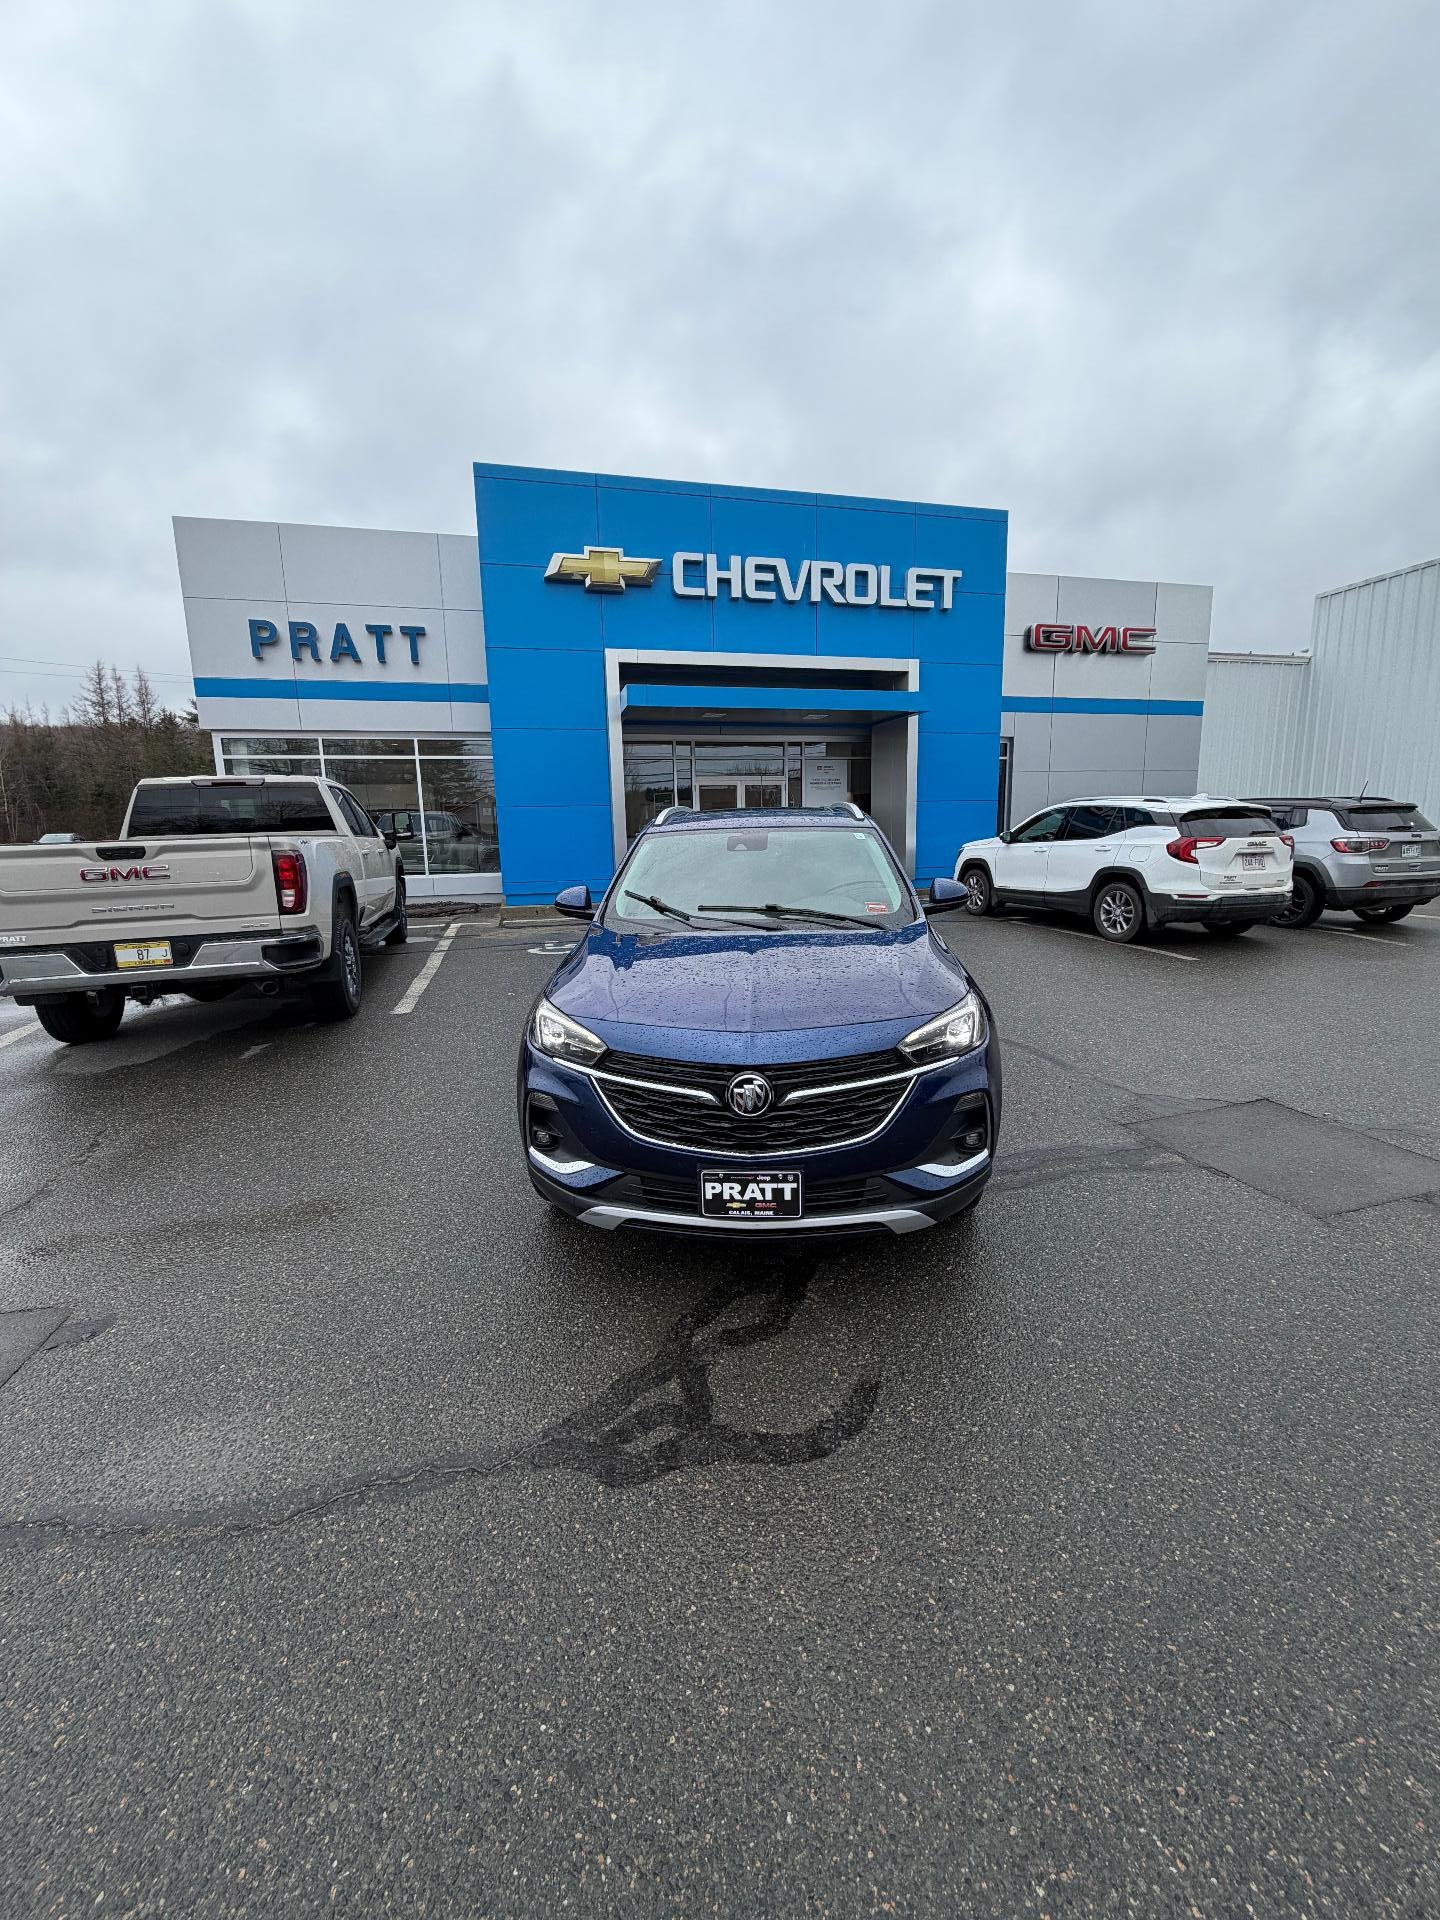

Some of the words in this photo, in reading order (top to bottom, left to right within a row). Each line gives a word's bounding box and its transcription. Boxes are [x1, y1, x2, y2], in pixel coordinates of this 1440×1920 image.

[672, 551, 963, 610] CHEVROLET
[248, 619, 427, 665] PRATT
[1025, 623, 1157, 655] GMC
[80, 864, 171, 882] GMC
[136, 949, 150, 961] 87
[704, 1182, 797, 1200] PRATT
